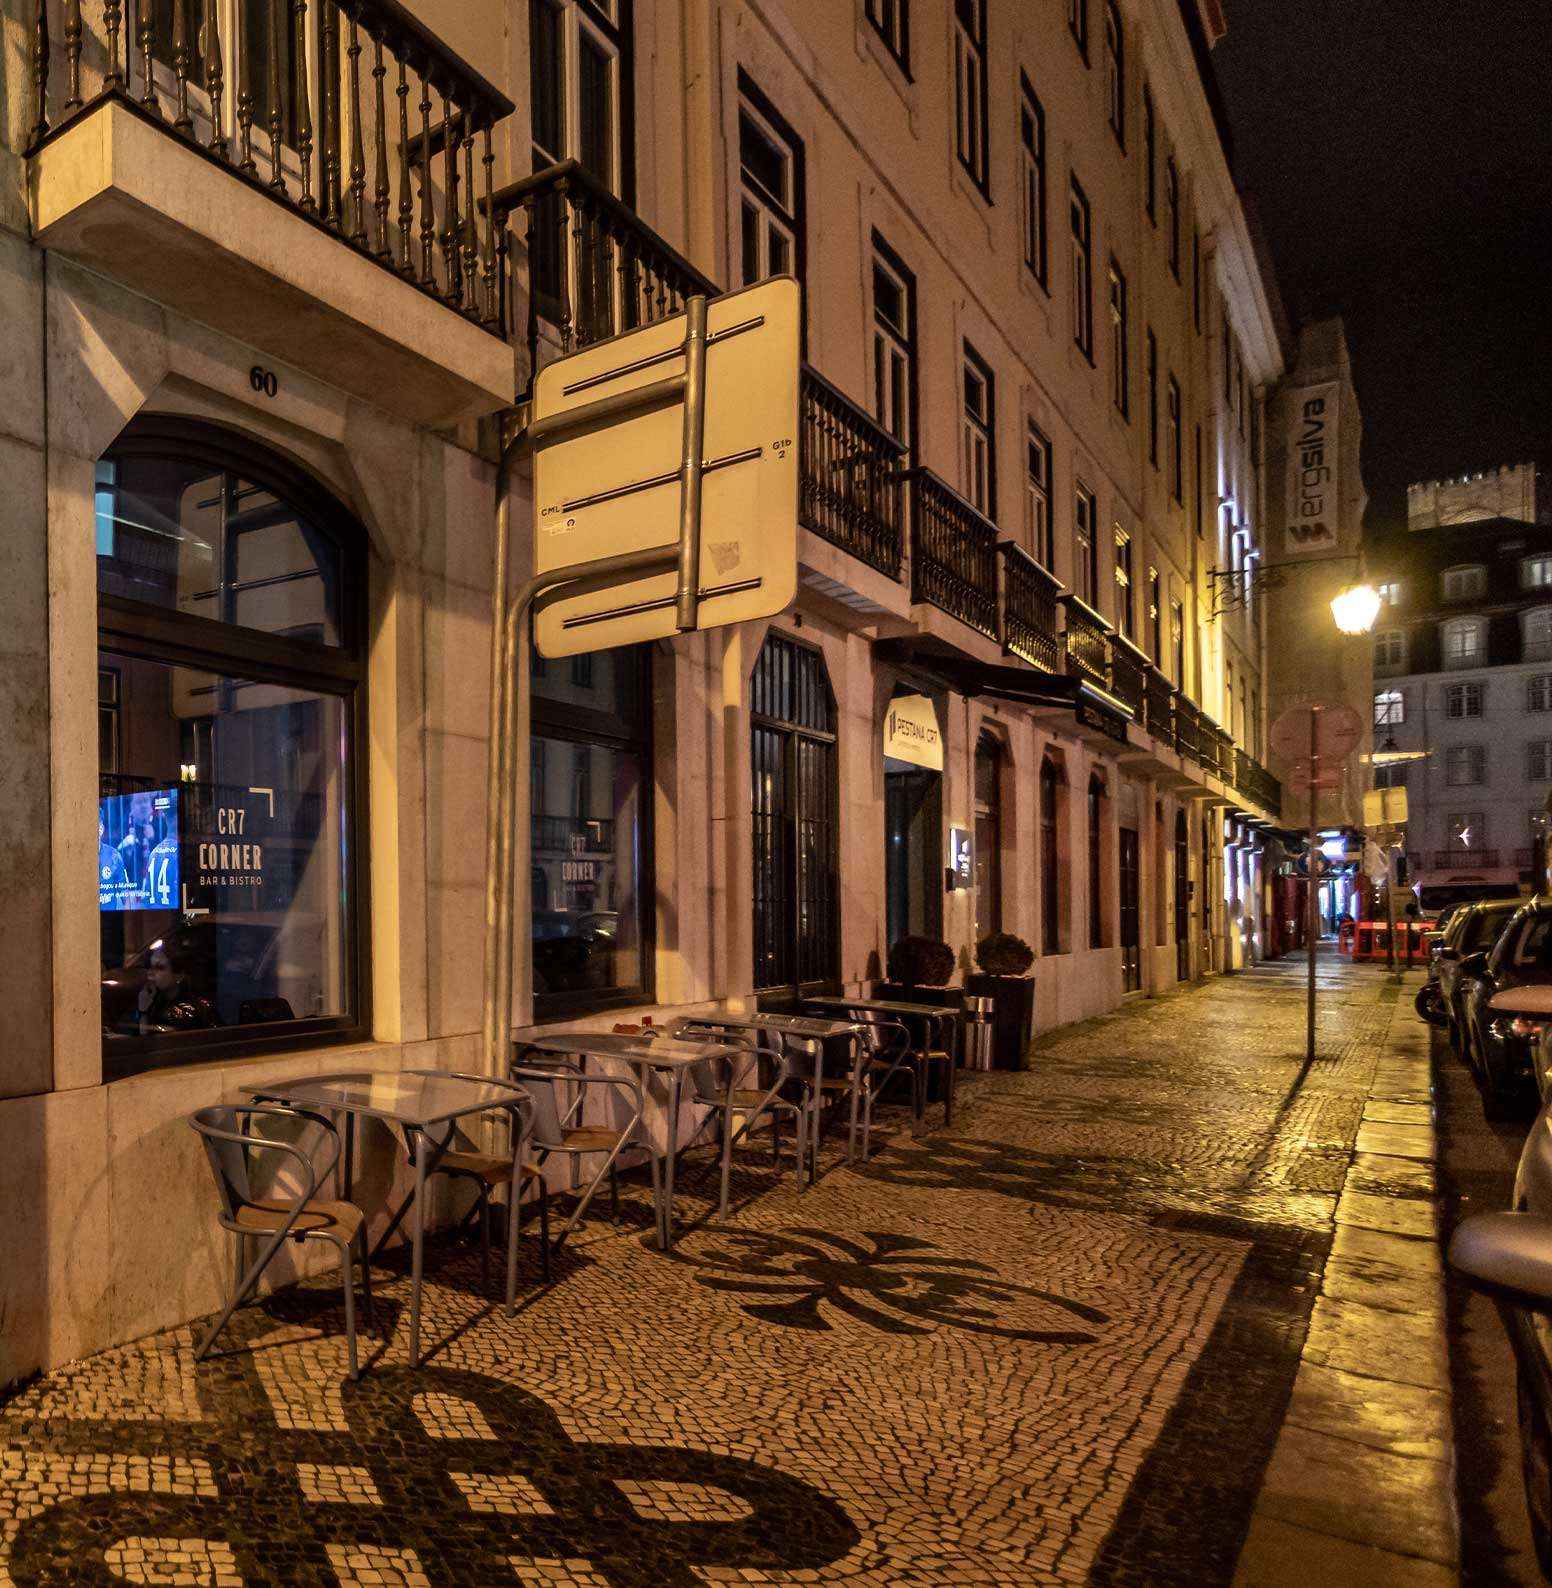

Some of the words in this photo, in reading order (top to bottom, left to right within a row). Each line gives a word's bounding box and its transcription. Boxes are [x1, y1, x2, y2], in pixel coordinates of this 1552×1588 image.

[250, 366, 277, 397] 60
[778, 449, 786, 459] 2
[1296, 398, 1330, 518] ergsilva
[541, 506, 560, 516] CML
[897, 718, 926, 740] PESTANA
[927, 728, 938, 744] CR7
[218, 807, 245, 835] CR7
[199, 843, 261, 870] CORNER
[148, 857, 170, 904] 14
[200, 876, 218, 886] BAR
[221, 876, 227, 886] &
[229, 876, 262, 886] BISTRO
[562, 862, 594, 881] CORNER
